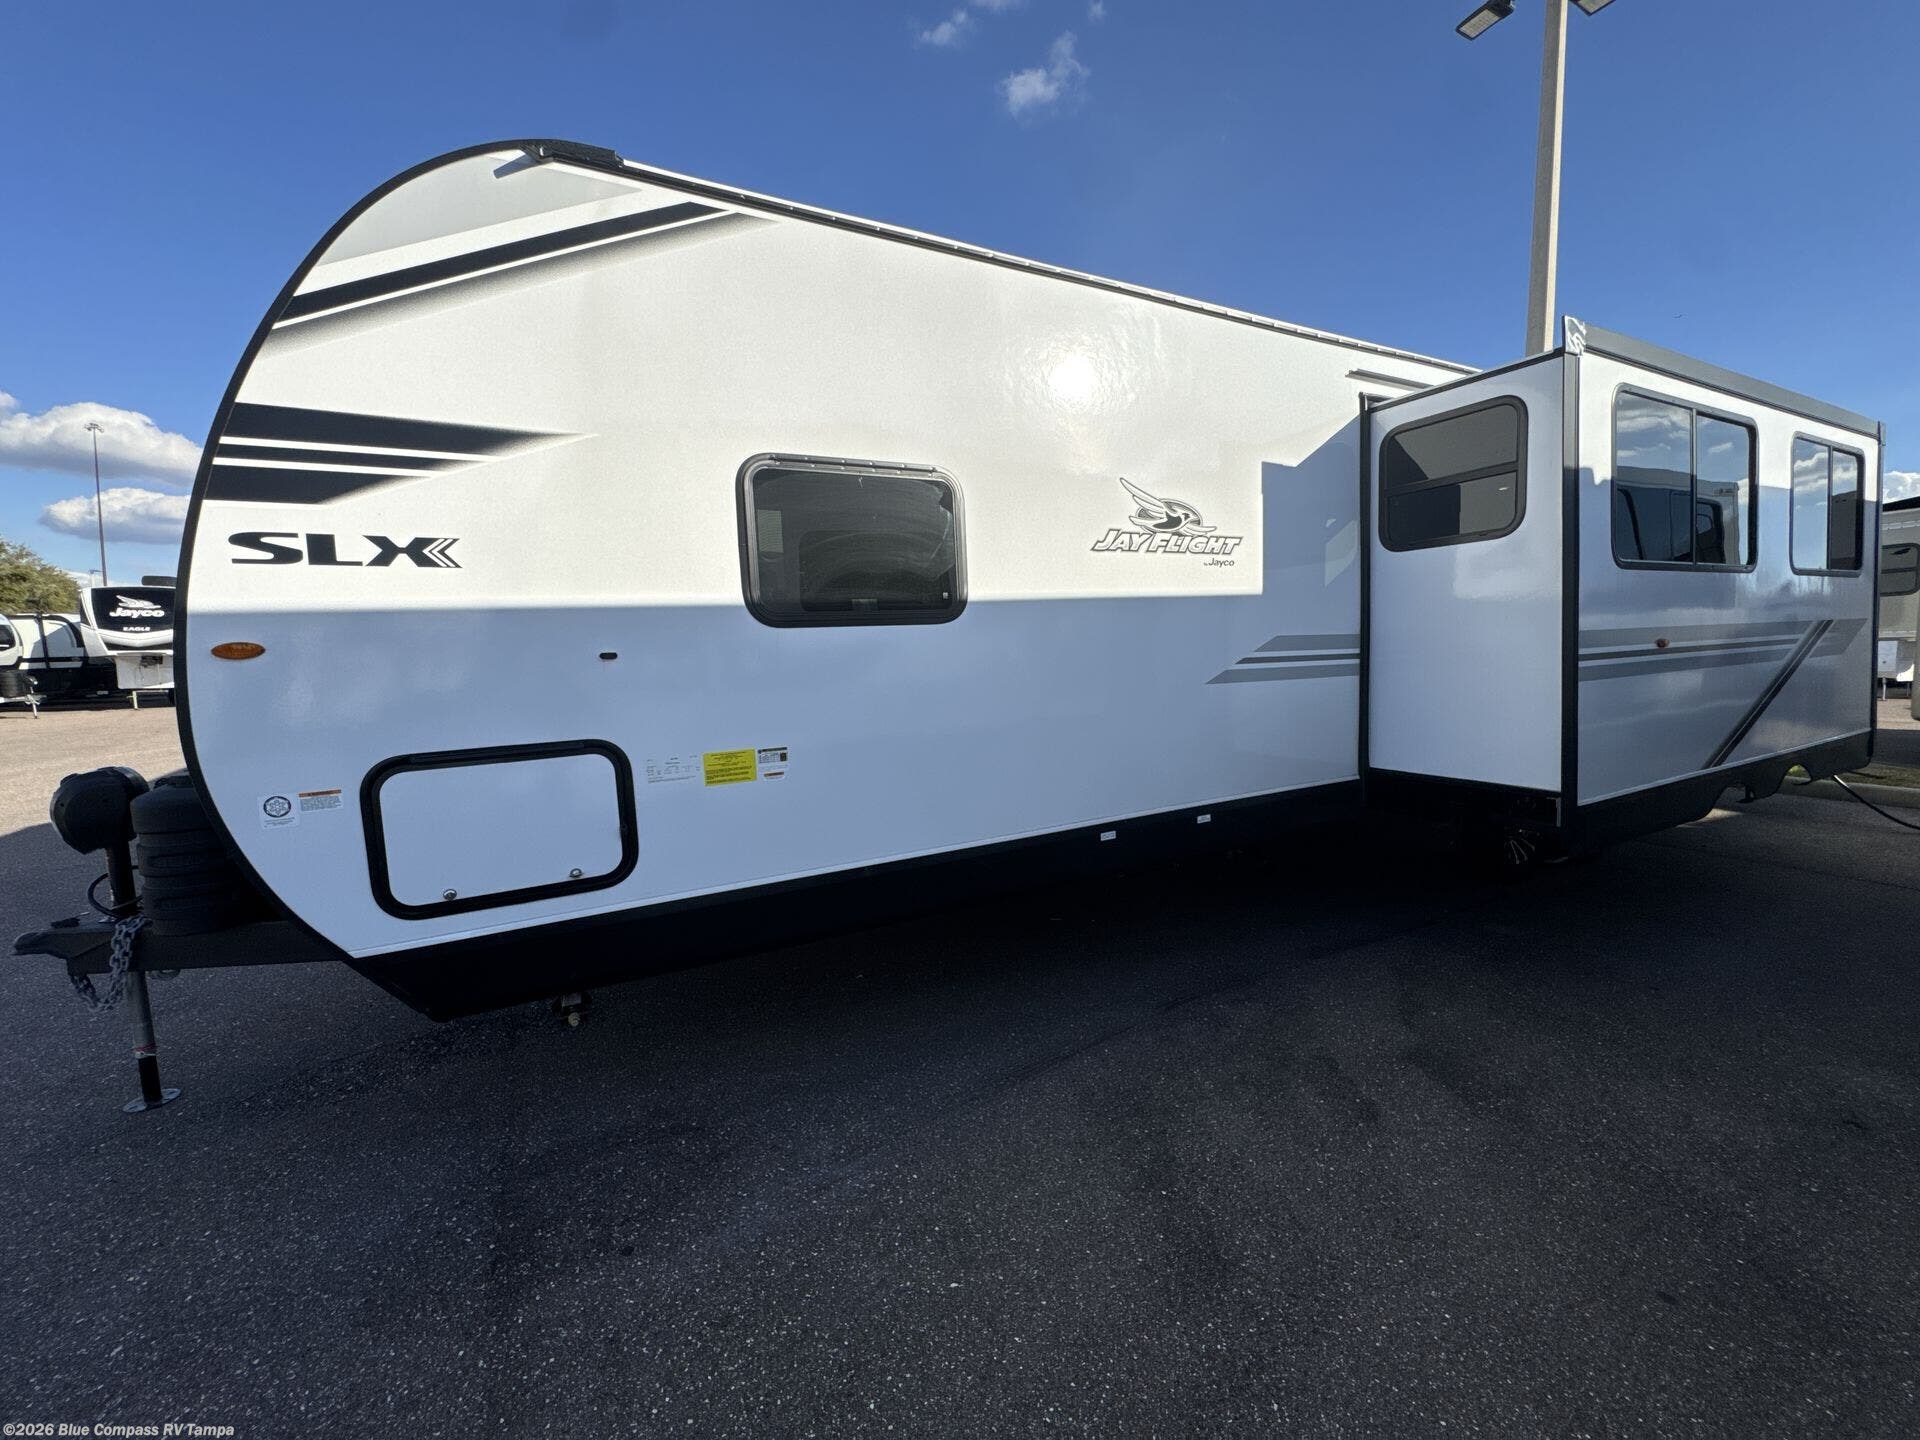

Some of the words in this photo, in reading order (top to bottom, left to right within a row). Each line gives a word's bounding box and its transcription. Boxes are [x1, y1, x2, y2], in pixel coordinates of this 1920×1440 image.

[228, 531, 463, 569] SLX
[1091, 528, 1153, 552] JAY
[1146, 531, 1244, 555] FLIGHT
[1208, 557, 1235, 568] Jayco
[109, 607, 165, 619] Jayco
